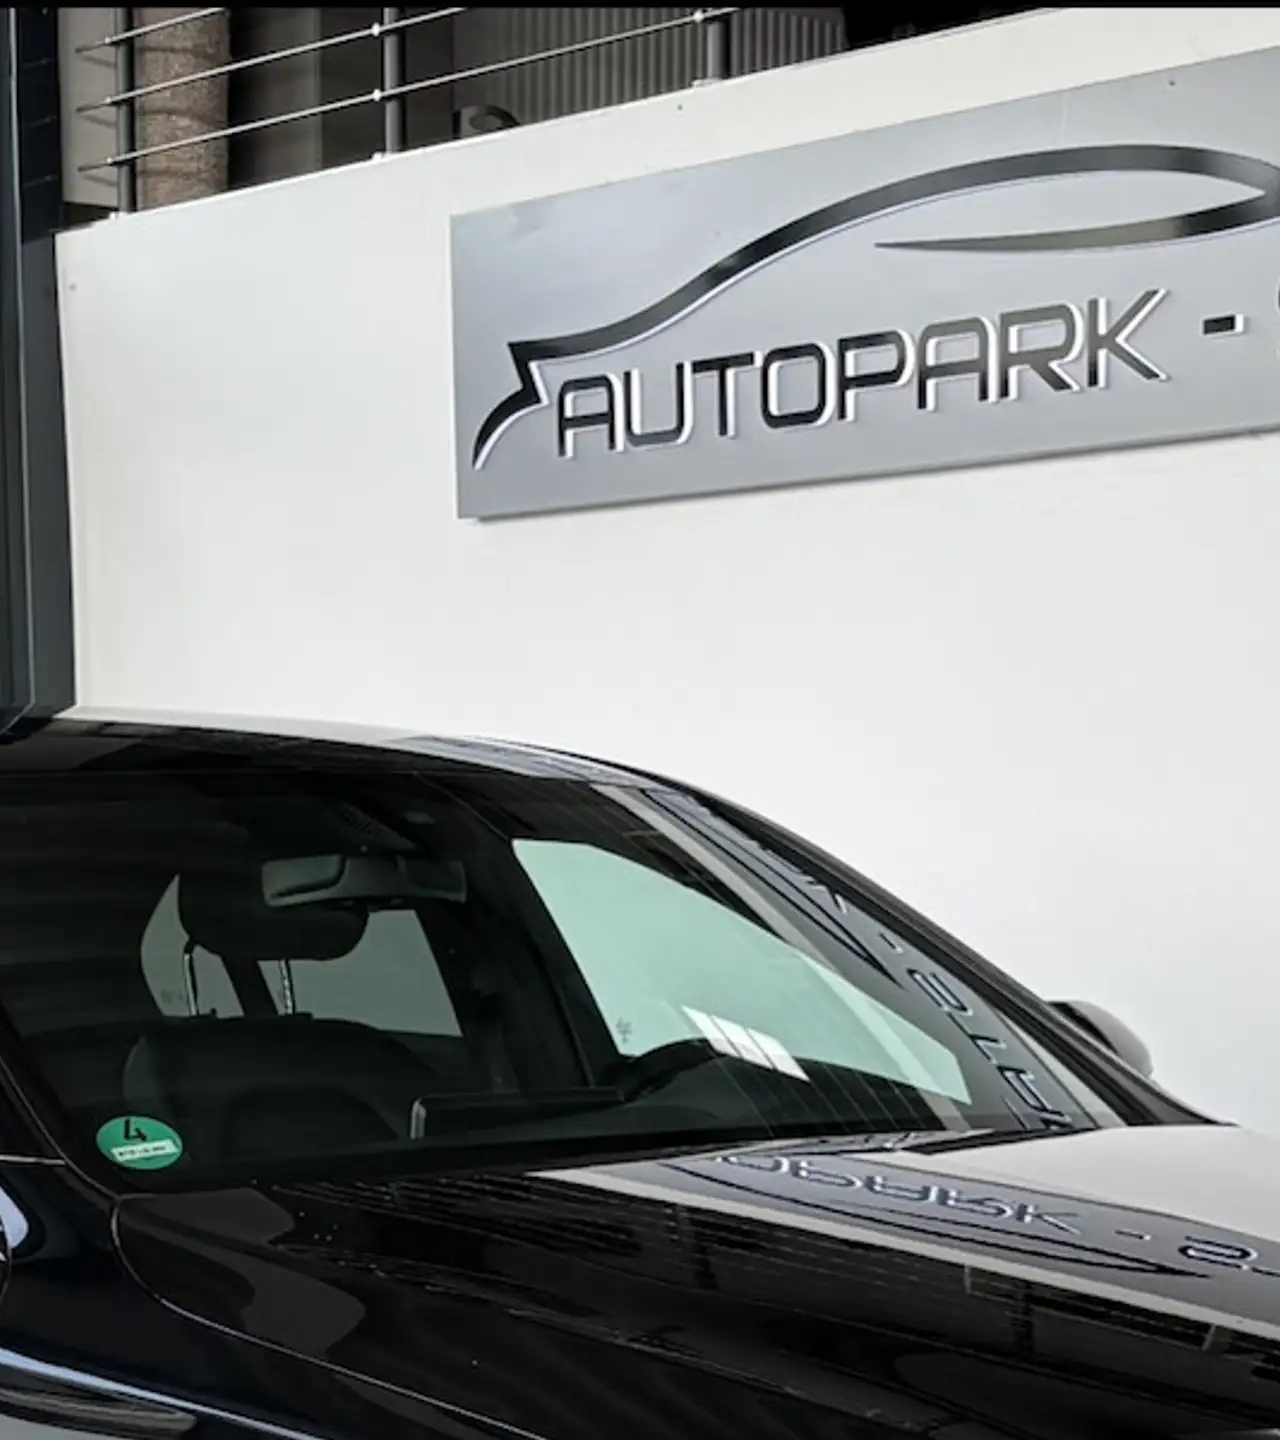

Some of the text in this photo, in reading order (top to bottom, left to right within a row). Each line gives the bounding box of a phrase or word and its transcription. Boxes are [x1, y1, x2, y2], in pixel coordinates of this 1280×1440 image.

[558, 289, 1169, 457] AUTOPARK
[1202, 313, 1246, 336] -
[124, 1118, 148, 1141] 4
